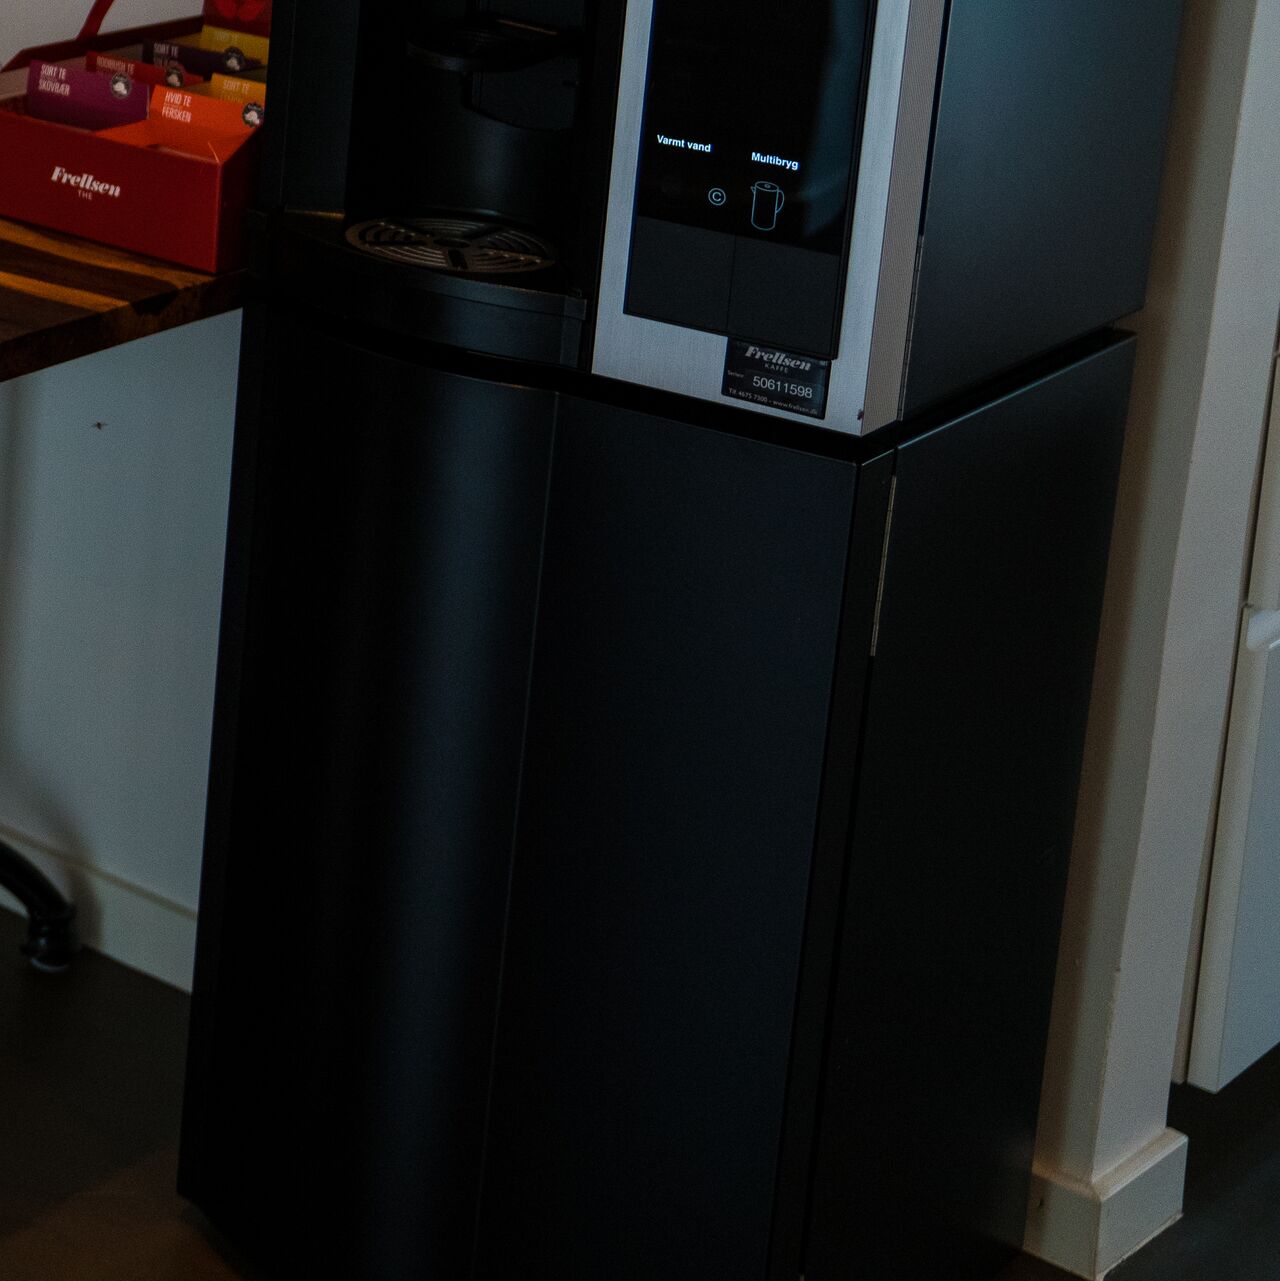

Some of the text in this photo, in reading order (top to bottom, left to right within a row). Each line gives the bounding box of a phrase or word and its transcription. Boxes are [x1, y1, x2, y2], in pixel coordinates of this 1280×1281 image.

[41, 64, 67, 80] SORT TE
[165, 91, 192, 108] HVID TE
[162, 106, 192, 124] FERSKEN
[656, 133, 713, 153] Varmt vand
[751, 151, 800, 171] Multibryg
[50, 165, 122, 198] Frellsen
[77, 189, 93, 201] THE
[745, 345, 812, 371] Frellsen
[764, 363, 789, 374] KAFFE
[752, 376, 813, 399] 50611598
